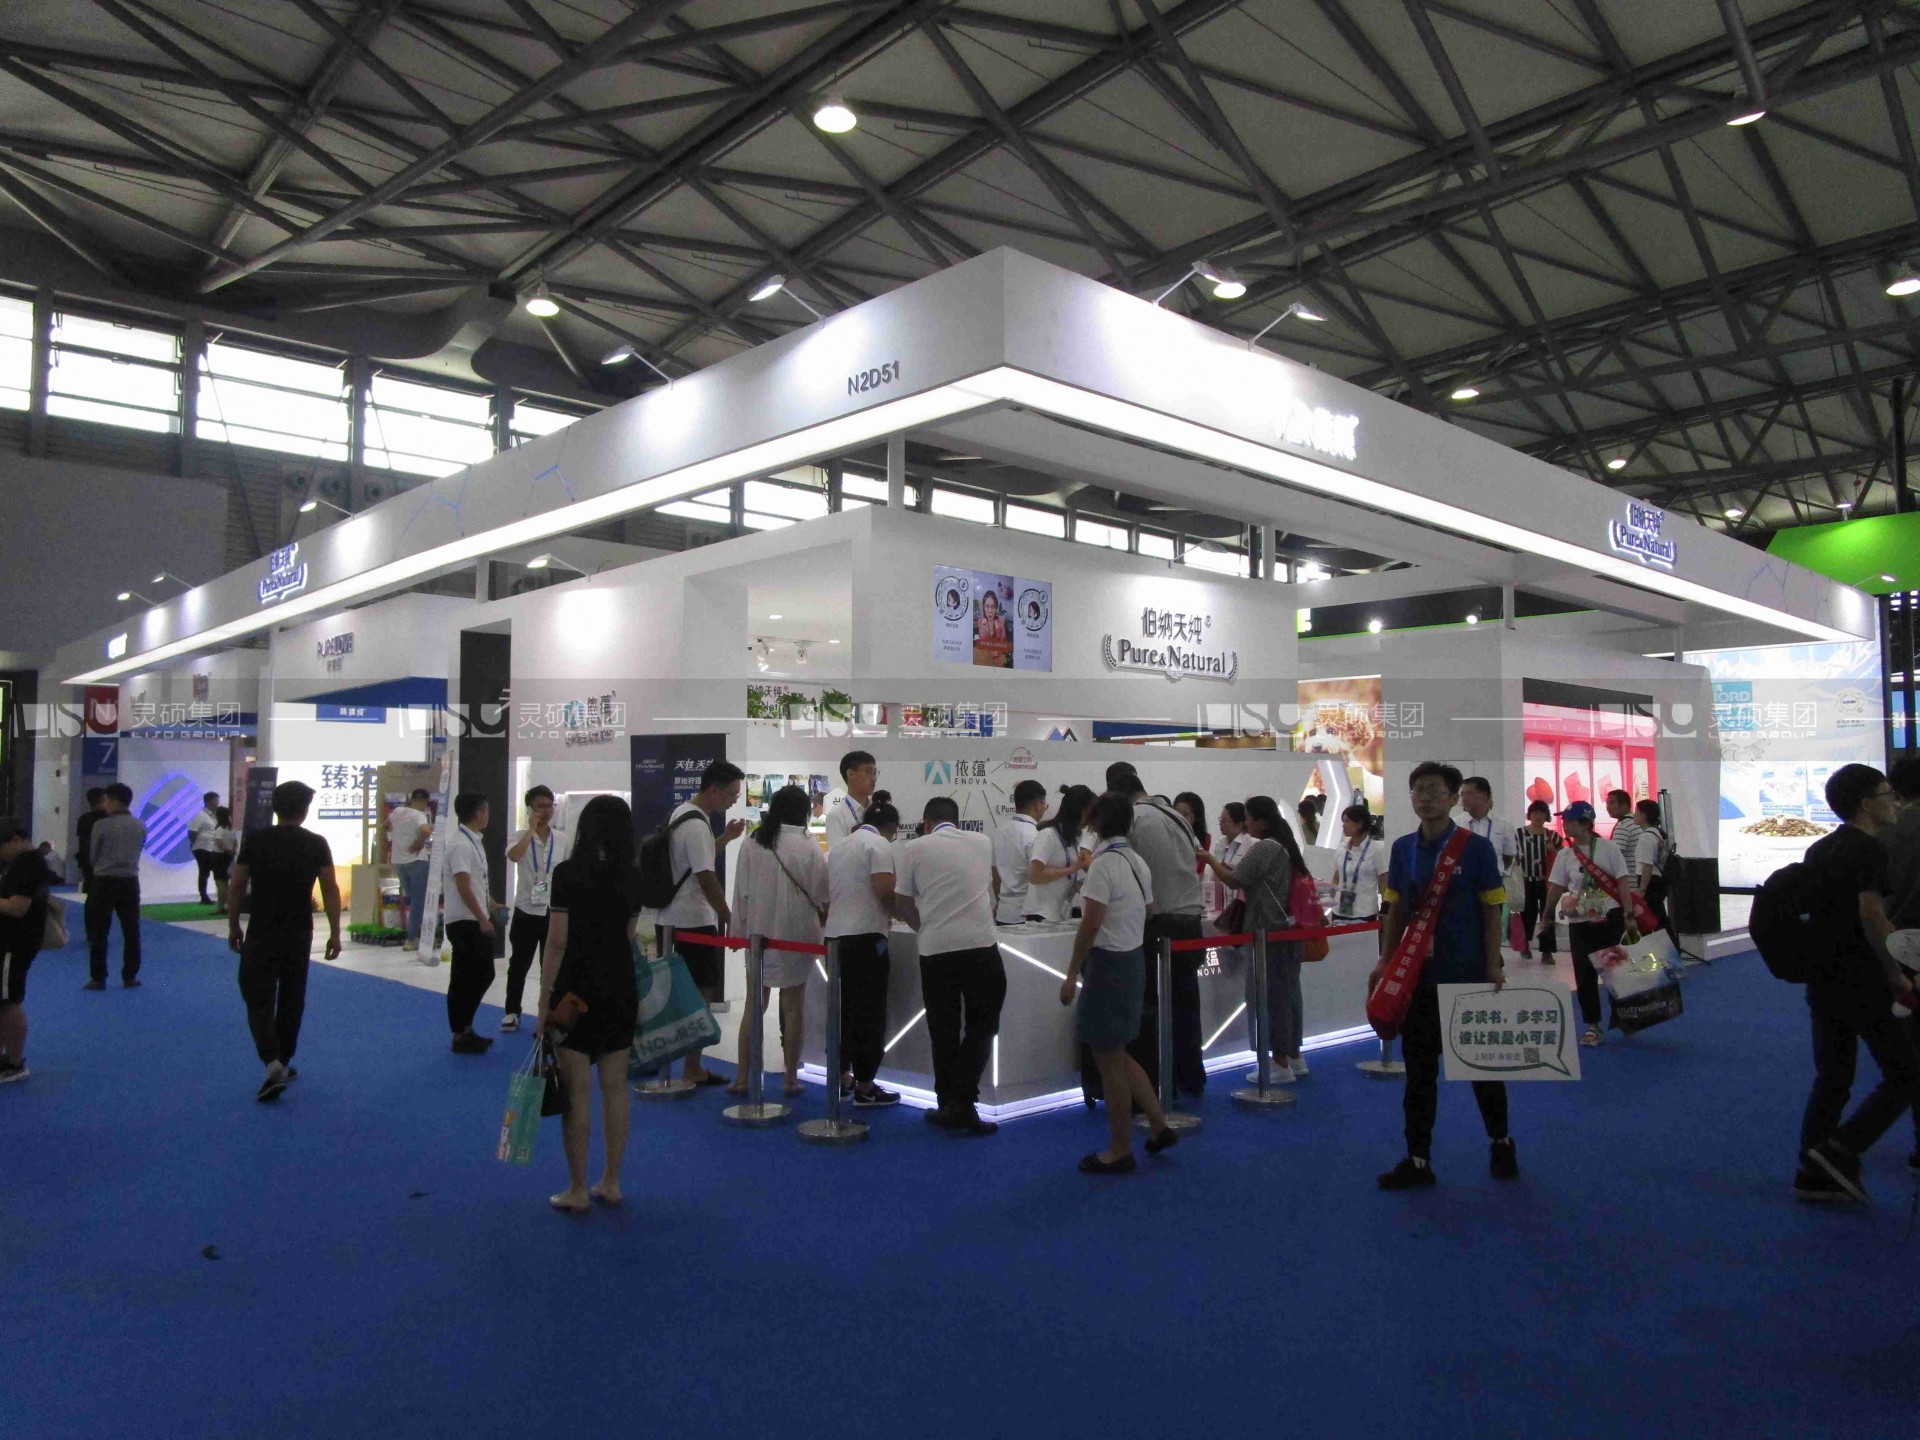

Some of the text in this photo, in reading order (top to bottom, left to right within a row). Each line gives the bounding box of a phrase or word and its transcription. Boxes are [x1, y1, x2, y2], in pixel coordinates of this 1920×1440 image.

[848, 360, 900, 396] N2D51
[1141, 607, 1203, 644] 伯纳天纯
[1118, 638, 1226, 673] Pure&Natural
[100, 741, 115, 764] 7
[321, 763, 377, 790] 臻选
[954, 759, 986, 777] 依蕴
[954, 777, 987, 785] ENOVA
[1197, 966, 1222, 977] NOVA
[1459, 1031, 1557, 1046] 谁让我是小可爱
